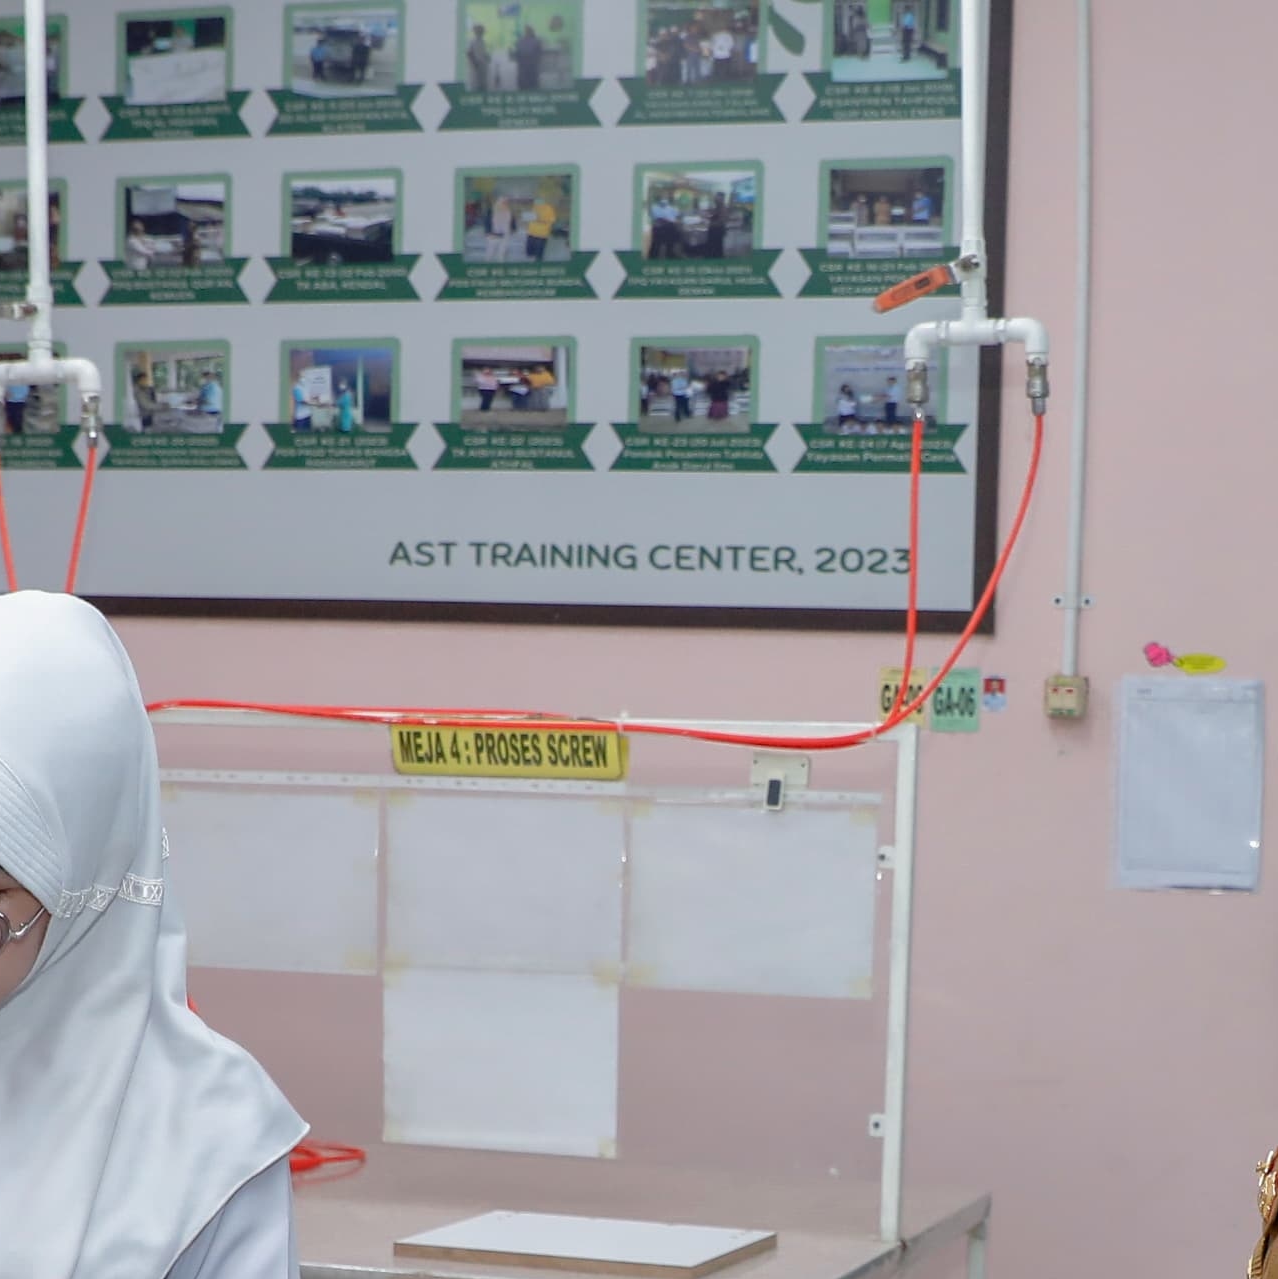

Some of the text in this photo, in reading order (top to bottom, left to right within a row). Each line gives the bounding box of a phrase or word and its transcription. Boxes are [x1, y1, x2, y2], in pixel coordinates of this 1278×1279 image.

[388, 540, 911, 576] AST TRAINING CENTER, 2023
[398, 730, 447, 765] MEJA
[449, 731, 462, 765] 4
[474, 732, 543, 767] PROSES
[547, 734, 609, 768] SCREW
